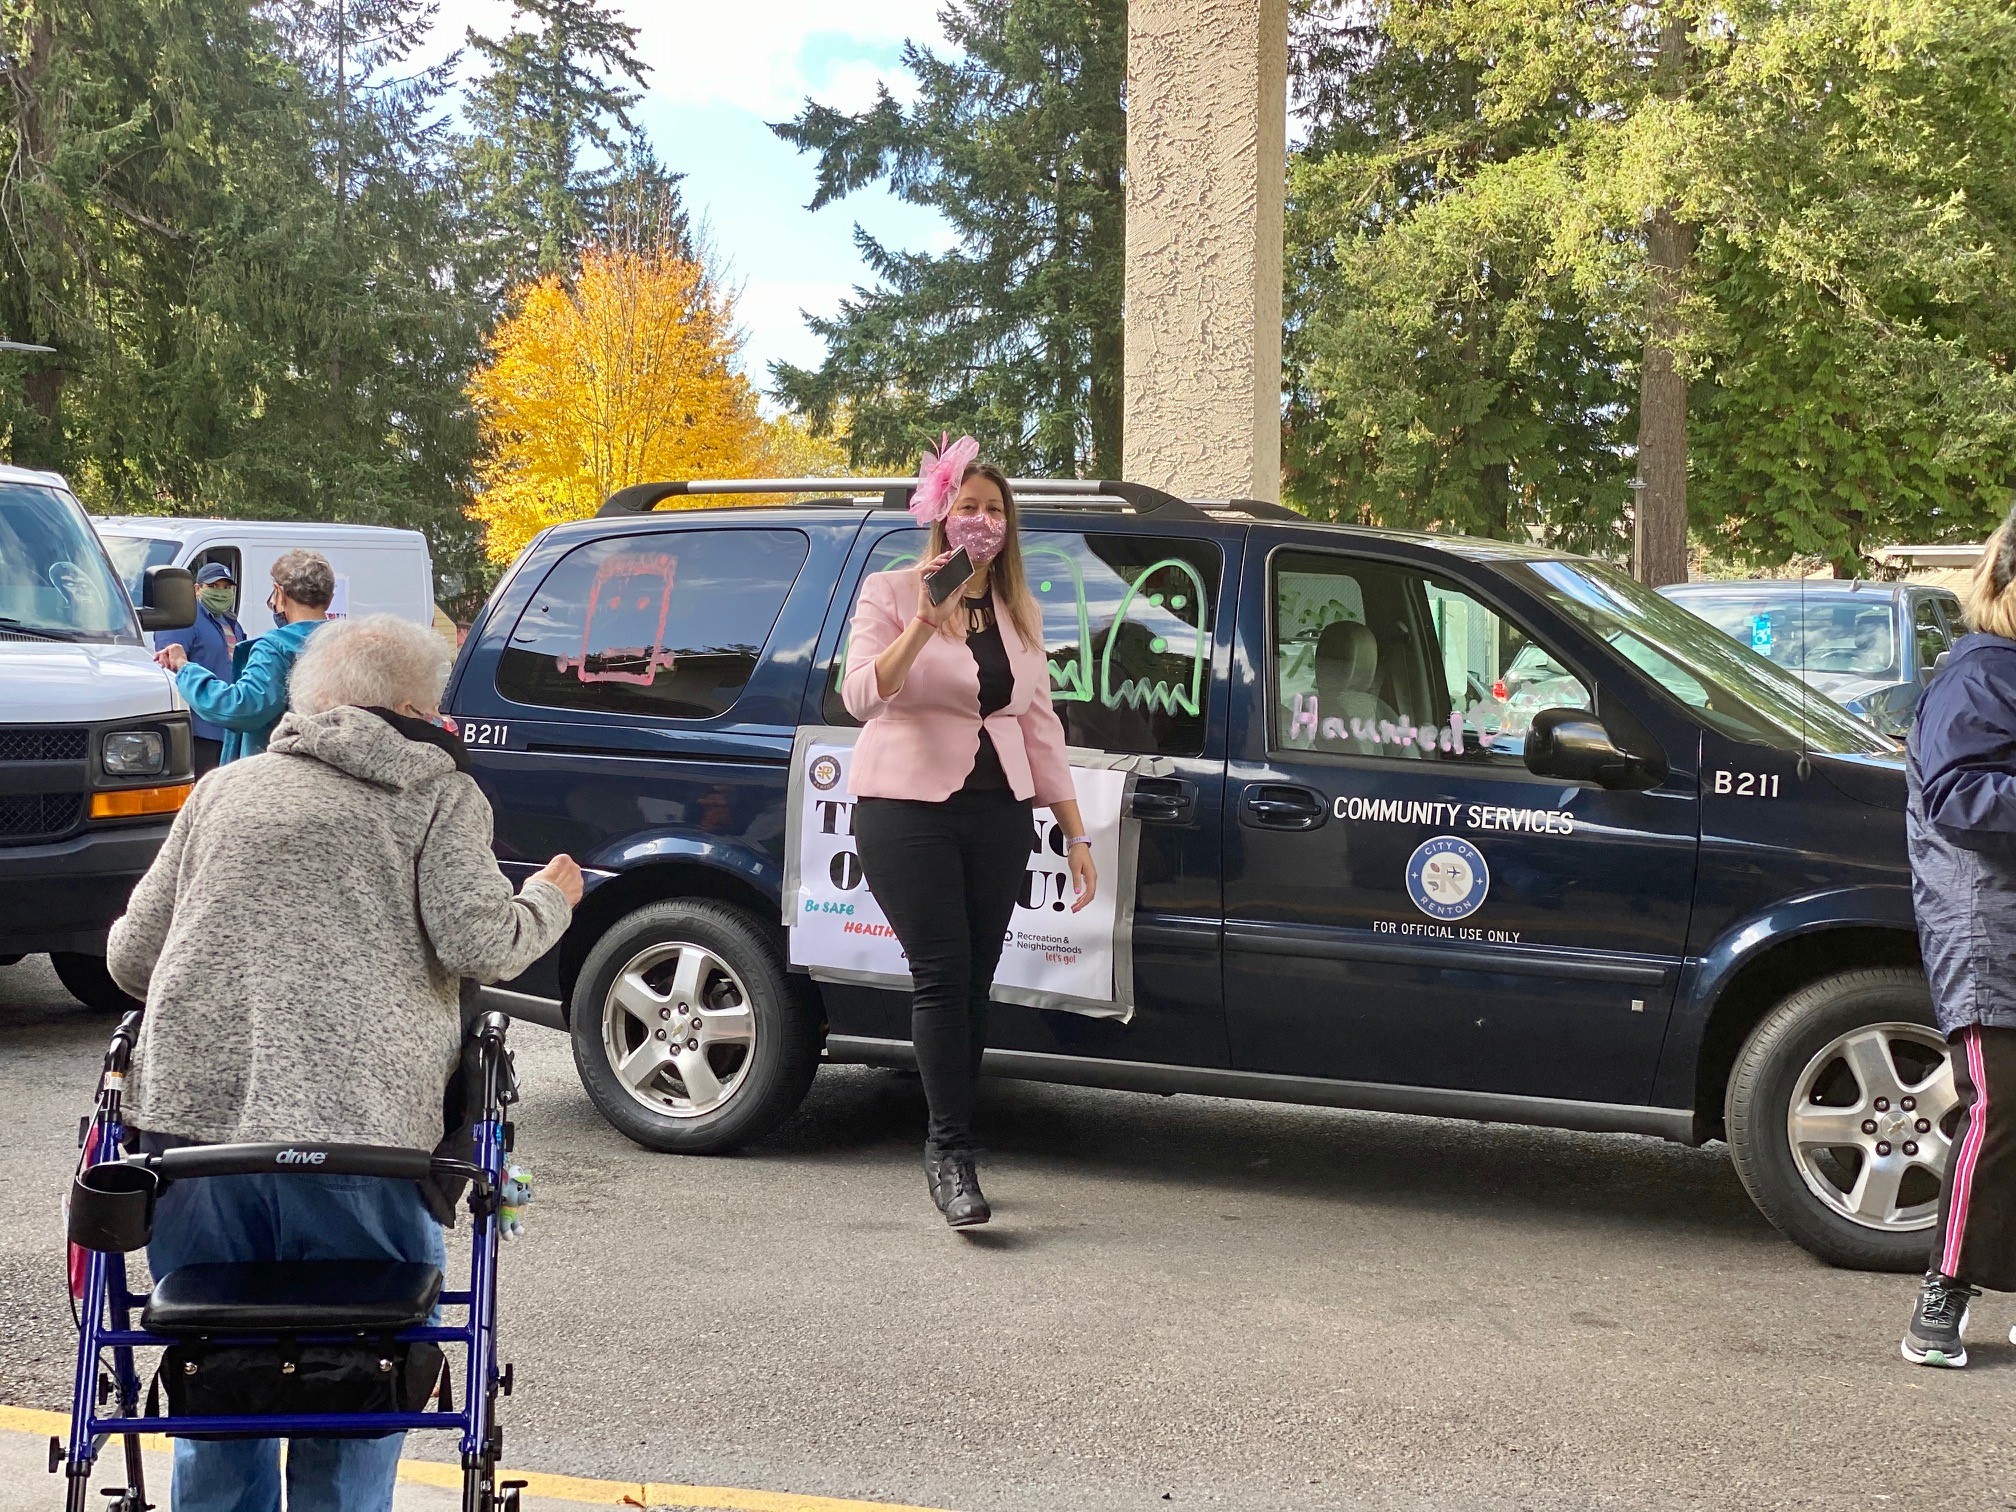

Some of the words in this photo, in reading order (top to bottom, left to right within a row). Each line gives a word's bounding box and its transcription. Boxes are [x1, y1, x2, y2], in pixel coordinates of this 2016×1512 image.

[1289, 692, 1465, 755] Haunted
[463, 723, 508, 745] B211
[1714, 770, 1779, 798] B211
[1333, 796, 1462, 826] COMMUNITY
[1466, 805, 1575, 835] SERVICES
[1424, 841, 1453, 856] CITY
[1458, 845, 1474, 859] OF
[804, 899, 820, 913] Be
[1420, 896, 1472, 915] RENTON
[844, 921, 900, 941] HEALTH
[1017, 931, 1062, 944] Recreation
[1063, 936, 1070, 944] &
[1373, 921, 1396, 934] FOR
[1401, 922, 1454, 938] OFFICIAL
[1459, 927, 1482, 941] USE
[1488, 930, 1520, 944] ONLY
[1017, 941, 1082, 954] Neighborhoods
[275, 1148, 326, 1165] drive
